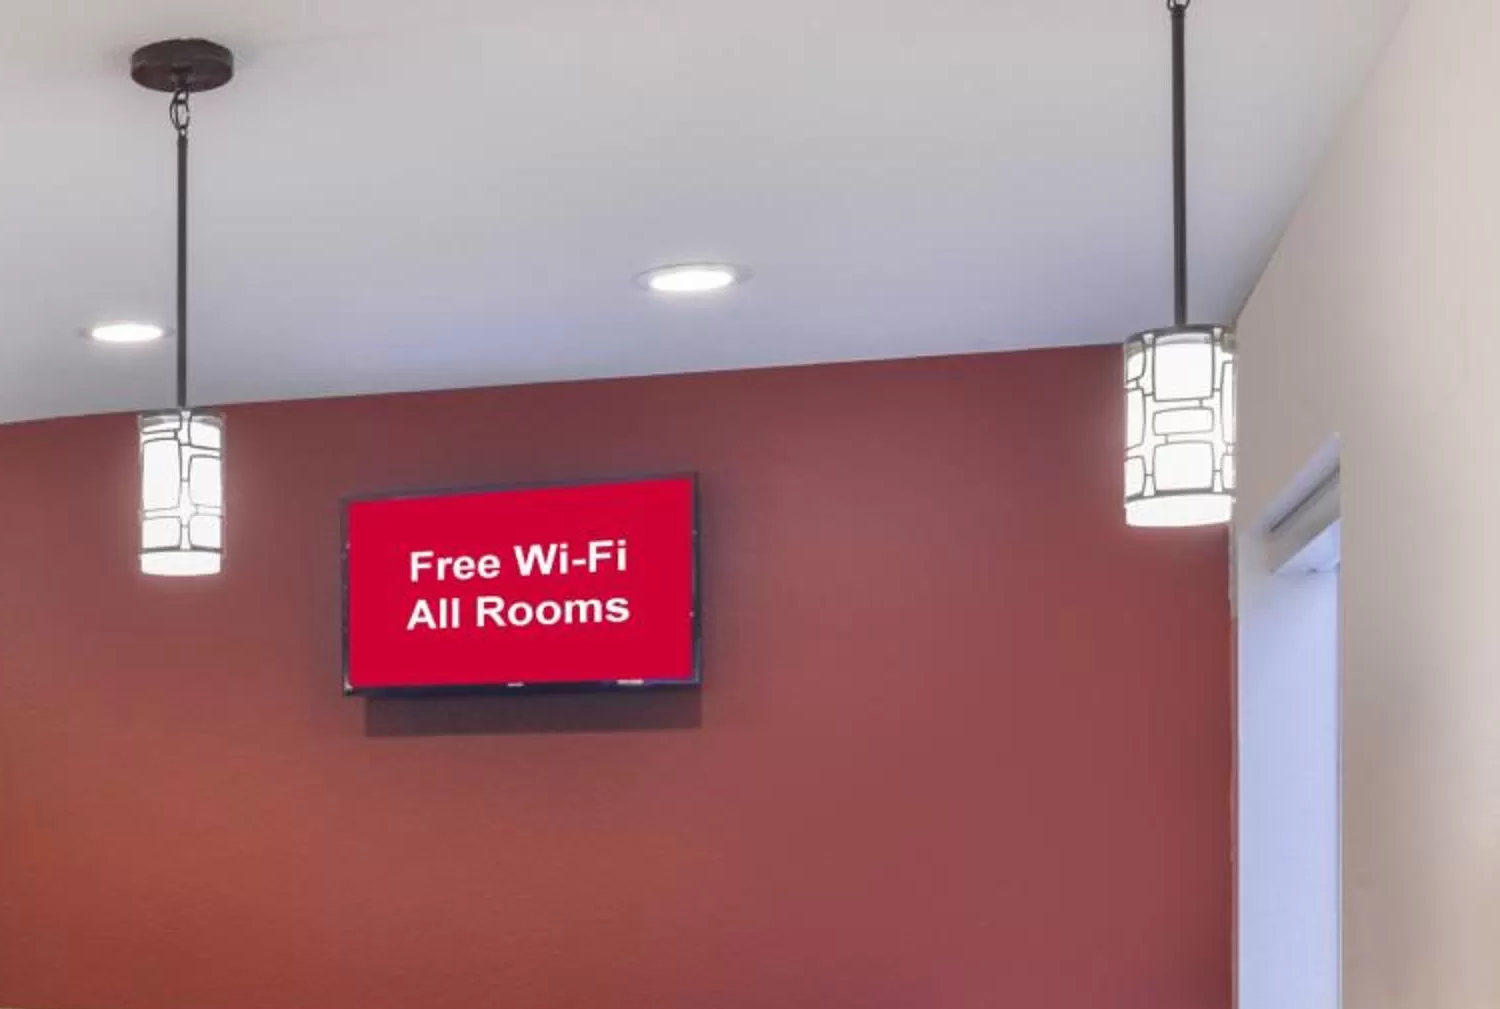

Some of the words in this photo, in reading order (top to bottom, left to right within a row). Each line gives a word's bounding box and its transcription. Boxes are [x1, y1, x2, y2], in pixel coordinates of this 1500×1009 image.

[410, 550, 501, 582] Free
[513, 539, 627, 577] Wi-Fi
[406, 597, 460, 631] All
[476, 595, 630, 628] Rooms
